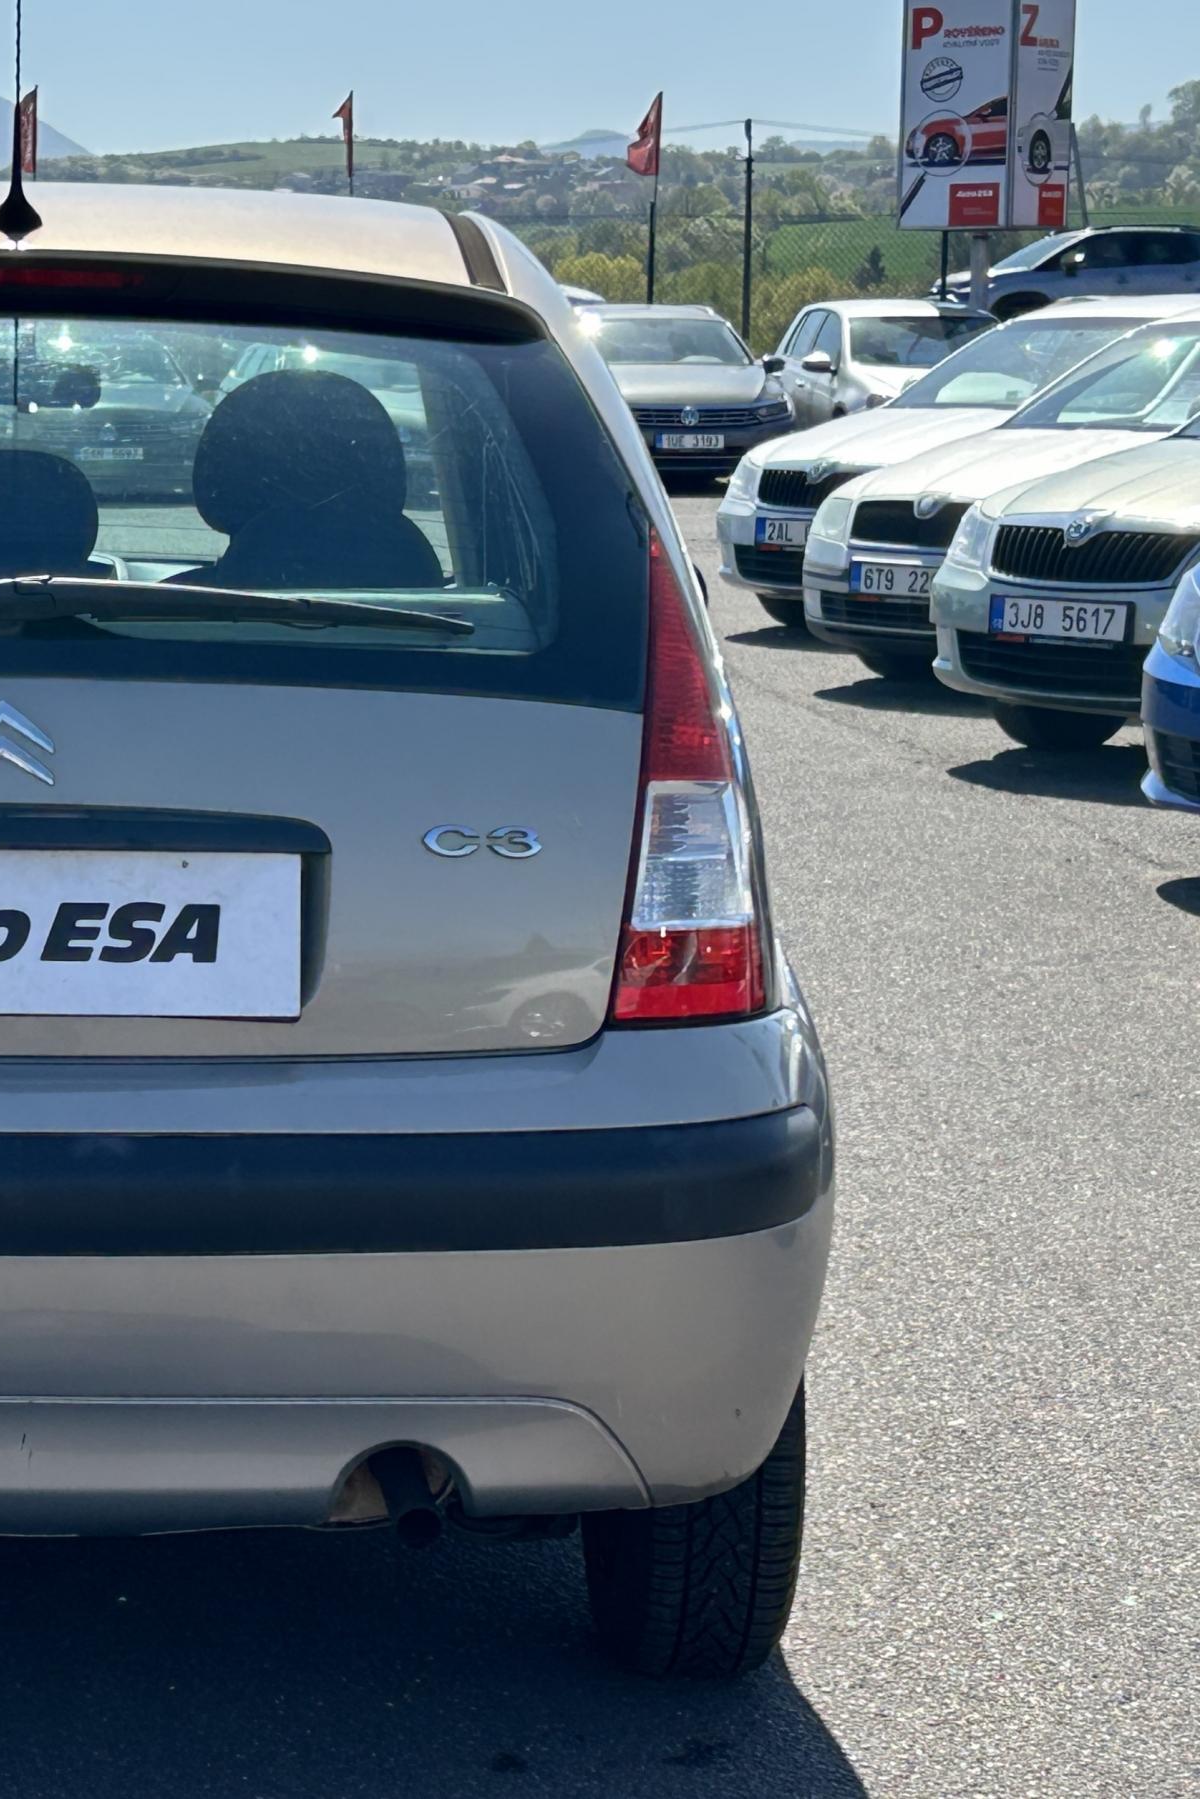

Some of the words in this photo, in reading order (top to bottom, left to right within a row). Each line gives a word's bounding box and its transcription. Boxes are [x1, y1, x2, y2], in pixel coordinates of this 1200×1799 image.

[767, 522, 793, 542] 2AL
[863, 568, 894, 591] 6T9
[907, 570, 935, 593] 22
[1008, 602, 1045, 630] 3J8
[1061, 606, 1116, 636] 5617
[421, 824, 543, 859] C3
[40, 901, 221, 963] ESA
